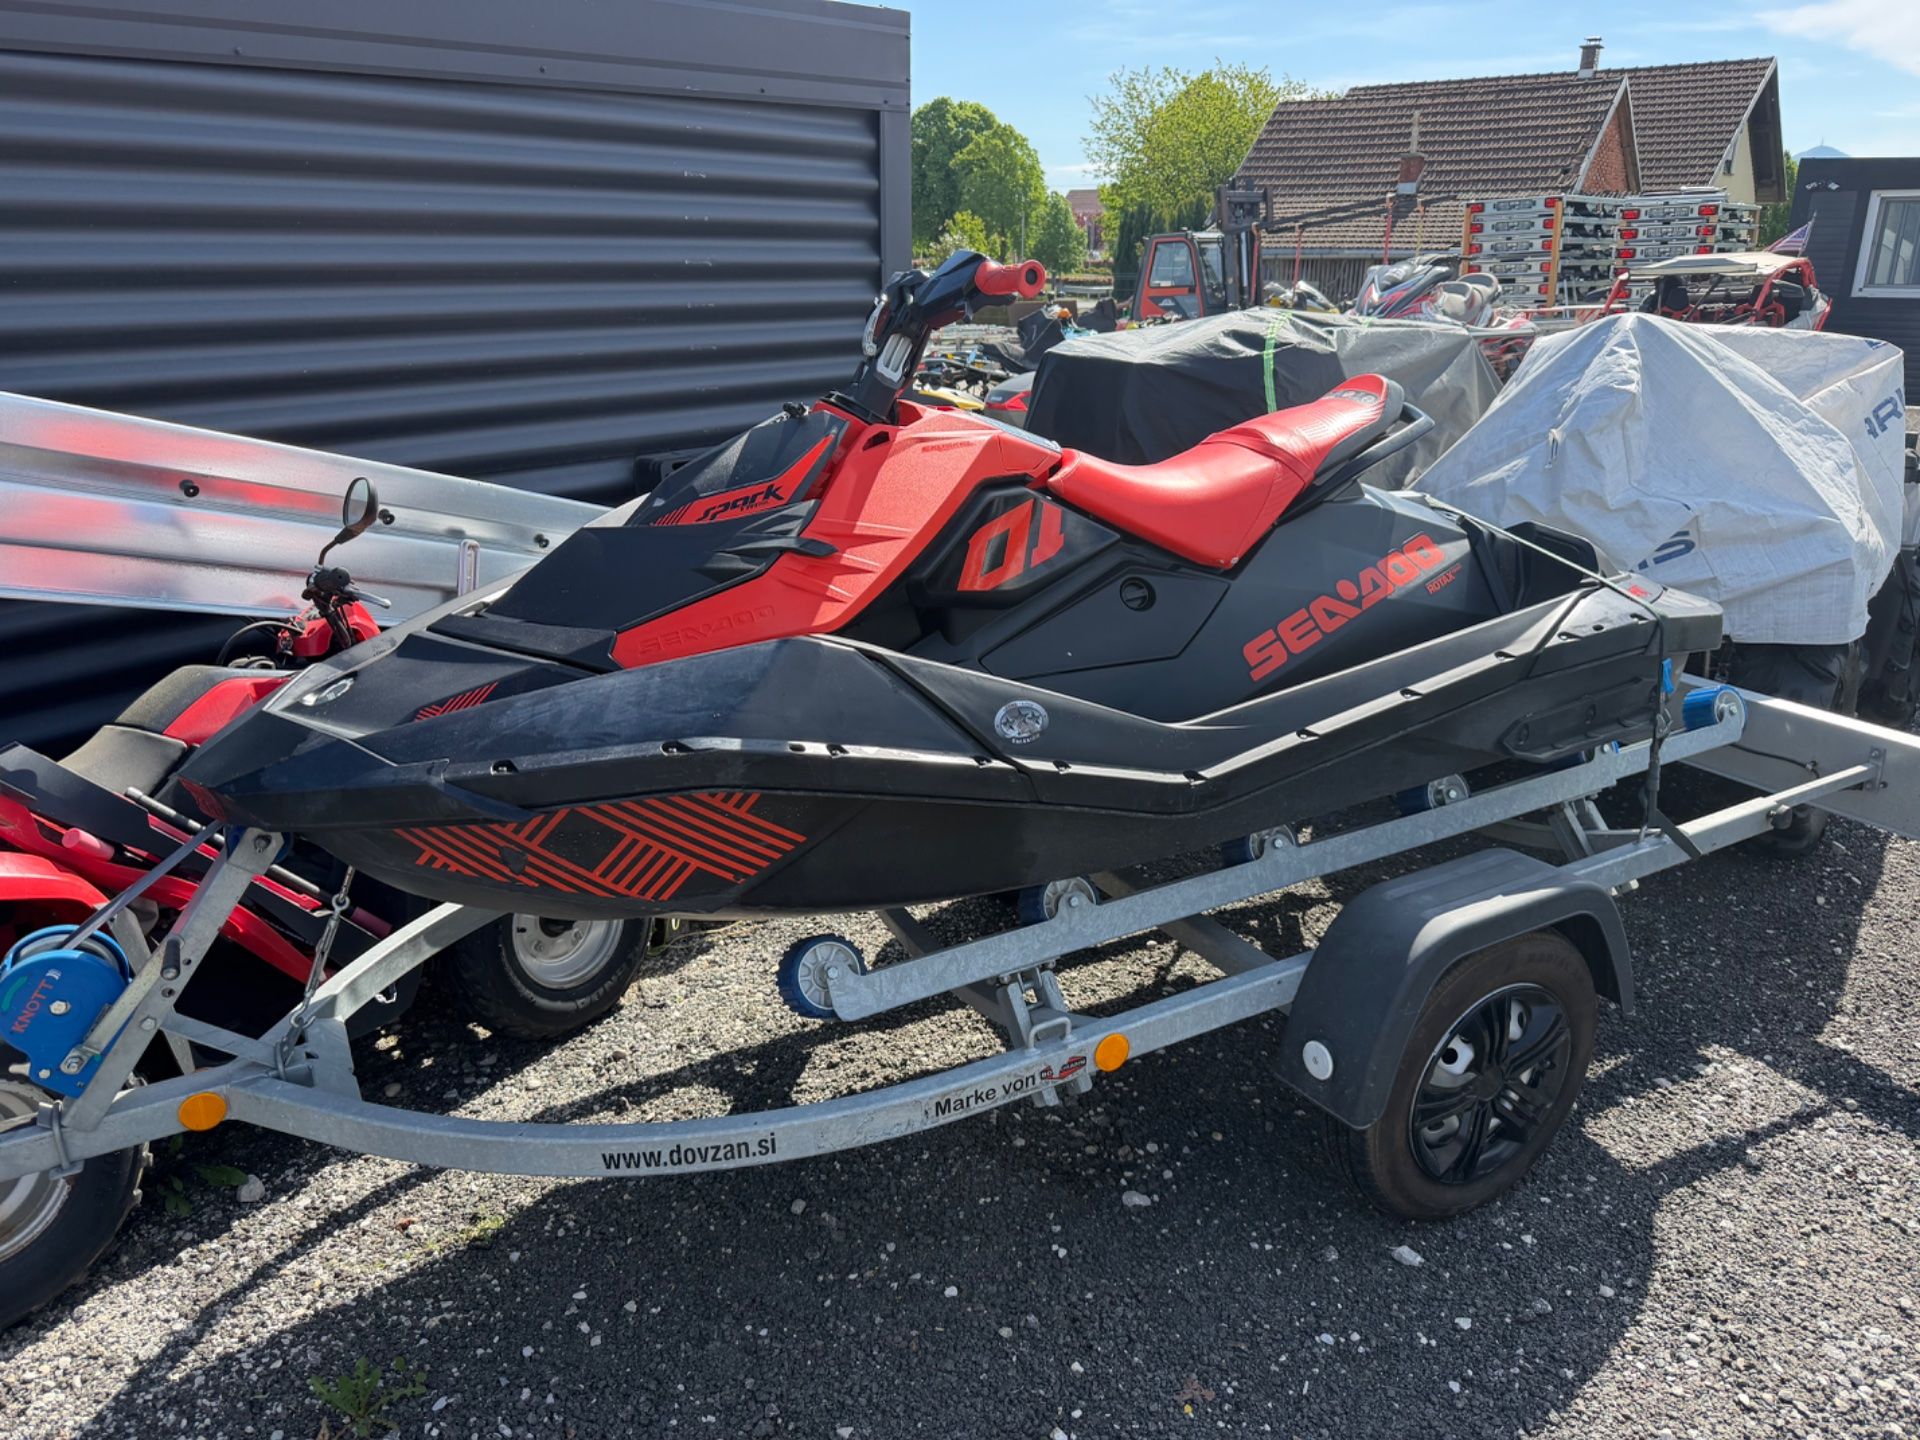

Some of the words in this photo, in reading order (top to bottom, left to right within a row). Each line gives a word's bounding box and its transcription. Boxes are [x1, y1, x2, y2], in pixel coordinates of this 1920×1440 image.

[1426, 571, 1456, 595] ROTAX
[11, 979, 54, 1034] KNOTT
[935, 1087, 997, 1117] Marke
[1002, 1073, 1035, 1095] von
[602, 1132, 777, 1170] www.dovzan.si
